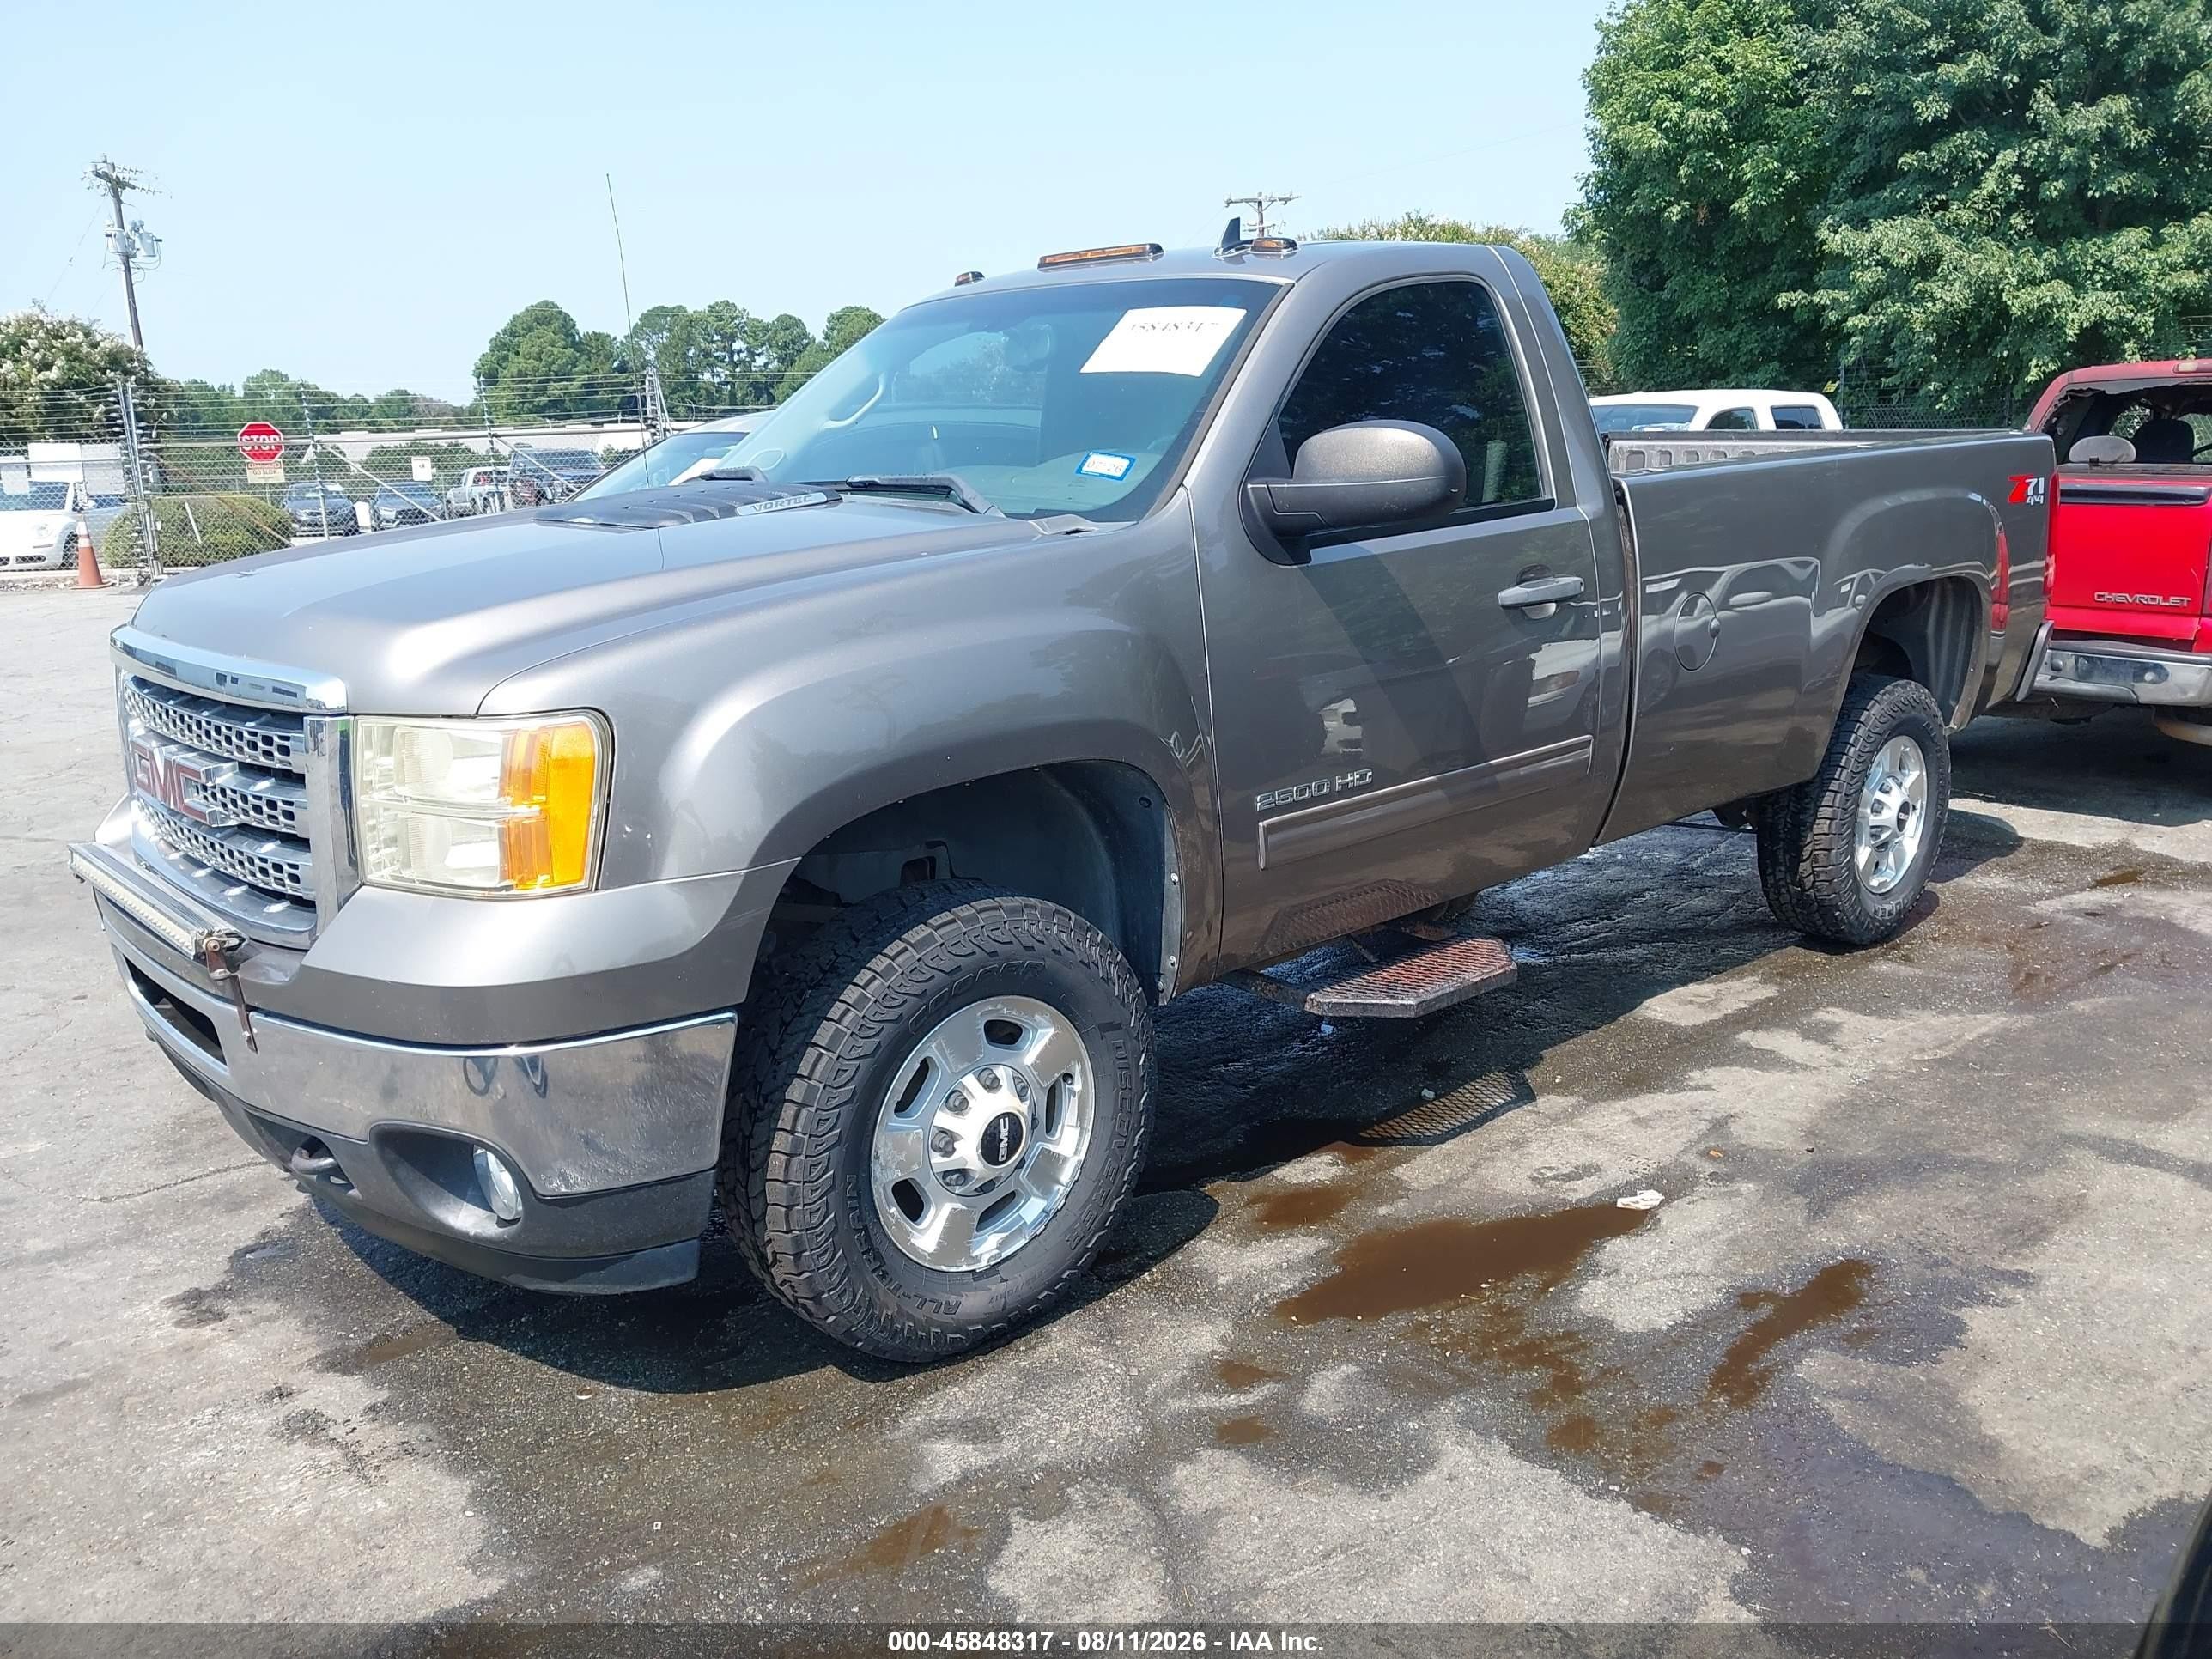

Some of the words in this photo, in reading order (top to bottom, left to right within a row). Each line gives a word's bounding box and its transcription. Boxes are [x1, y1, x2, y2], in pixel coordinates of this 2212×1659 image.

[242, 434, 279, 451] STOP
[750, 495, 812, 512] VORTEC
[2094, 592, 2192, 607] CHEVROLET
[130, 739, 210, 824] GMC
[1256, 778, 1330, 811] 2500
[1335, 768, 1373, 792] HD
[998, 1117, 1010, 1162] GMC
